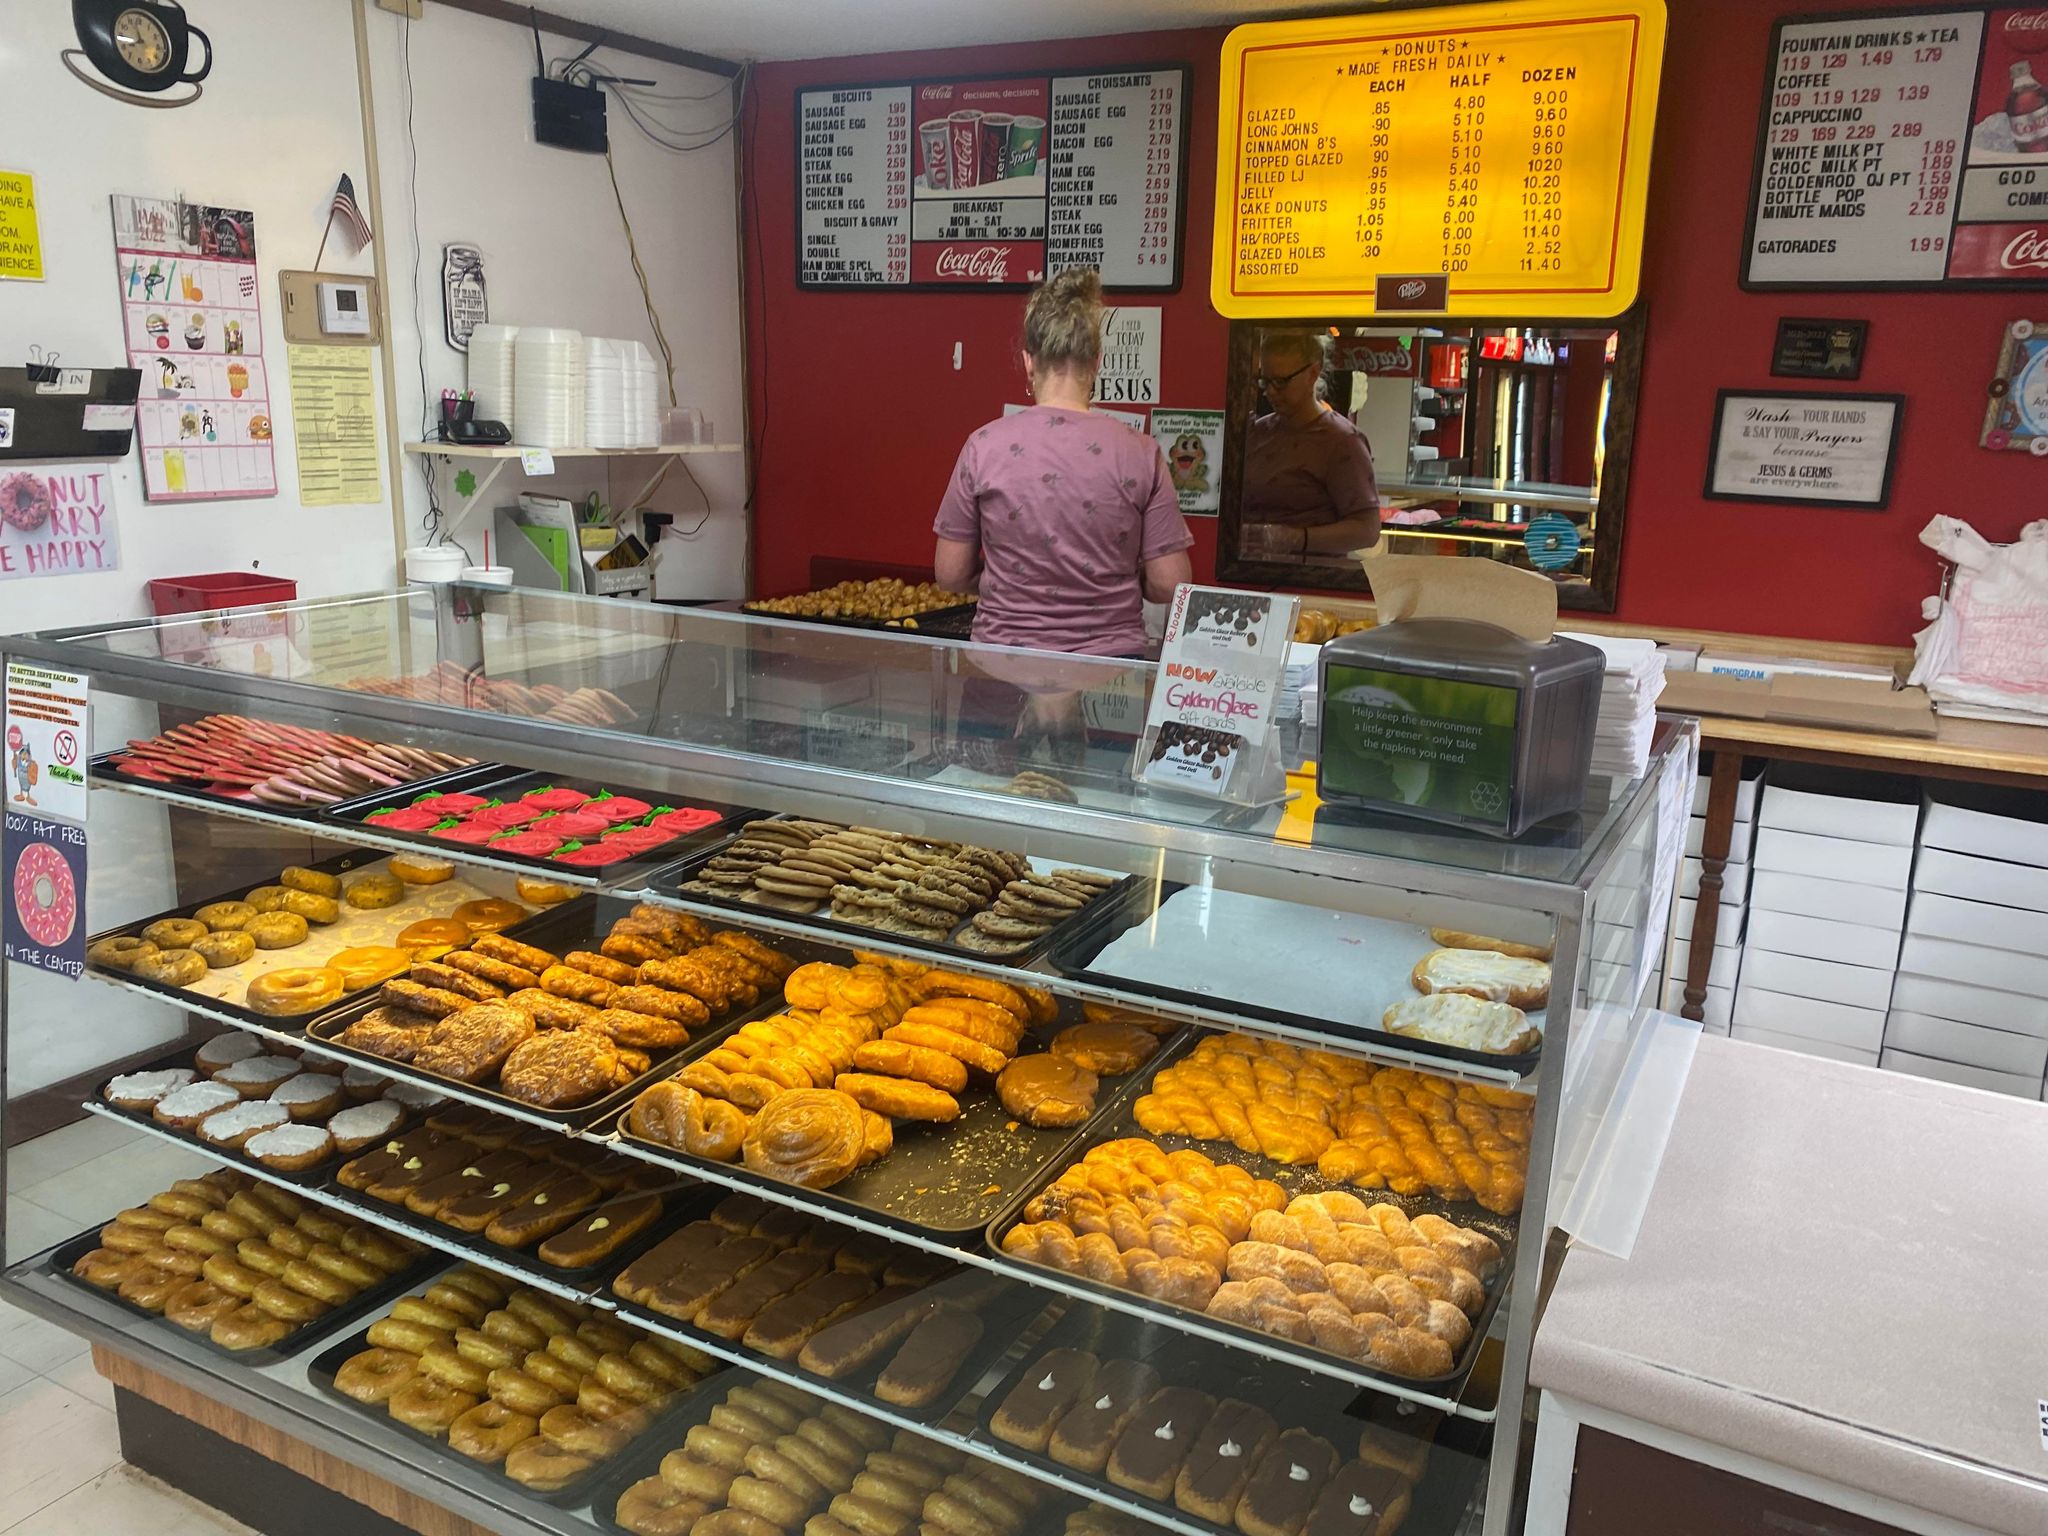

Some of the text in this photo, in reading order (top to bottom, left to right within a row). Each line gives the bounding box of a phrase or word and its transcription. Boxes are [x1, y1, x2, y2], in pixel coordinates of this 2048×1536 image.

[1782, 28, 1958, 52] FOUNTAIN DRINKS TEA
[1395, 39, 1455, 56] DONUTS
[1349, 54, 1490, 76] MADE FRESH DAILY
[1088, 75, 1151, 90] CROISSANTS
[1370, 67, 1576, 92] EACH HALF DOZEN
[1779, 73, 1830, 90] COFFEE
[833, 91, 872, 103] BISCUITS
[963, 89, 1039, 100] decisions, decisions
[1056, 93, 1101, 106] SAUSAGE
[805, 106, 845, 118] SAUSAGE
[1054, 106, 1126, 120] SAUSAGE EGG
[1248, 91, 1567, 122] GLAZED 9.00
[1772, 108, 1862, 125] CAPPUCCINO
[805, 119, 866, 131] SAUSAGE EGG
[1054, 123, 1085, 135] BACON
[1248, 122, 1318, 138] LONG JOHNS
[805, 133, 834, 144] BACON
[1054, 136, 1112, 150] BACON EGG
[804, 146, 853, 158] BACON EGG
[1246, 138, 1308, 153] CINNAMON
[1772, 143, 1884, 160] WHITE MILK PT
[1010, 147, 1037, 166] Sprite
[1053, 152, 1073, 163] HAM
[1246, 153, 1343, 168] TOPPED GLAZED
[805, 160, 831, 171] STEAK
[1052, 166, 1094, 178] HAM EGG
[1769, 159, 1882, 175] CHOC MILK PT
[806, 173, 852, 184] STEAK EGG
[1245, 170, 1304, 184] FILLED LJ
[1767, 172, 1910, 190] GOLDENROD OJ PT
[1999, 170, 2035, 185] GOD
[806, 187, 843, 197] CHICKEN
[1051, 180, 1093, 192] CHICKEN
[1241, 175, 1560, 199] JELLY 10.20
[1051, 194, 1117, 206] CHICKEN EGG
[1241, 191, 1560, 214] CAKE DONUTS 10.20
[1765, 189, 1864, 204] BOTTLE POP
[27, 200, 34, 209] A
[806, 199, 865, 210] CHICKEN EGG
[953, 202, 1003, 213] BREAKFAST
[1052, 210, 1081, 220] STEAK
[1763, 204, 1865, 219] MINUTE MAIDS
[824, 216, 898, 227] BISCUIT & GRAVY
[951, 216, 1001, 226] MON SAT
[1242, 208, 1561, 229] FRITTER 11.40
[966, 227, 1044, 237] UNTIL AM
[1051, 224, 1102, 235] STEAK EGG
[807, 235, 836, 245] SINGLE
[1049, 238, 1103, 249] HOMEFRIES
[1758, 240, 1836, 253] GATORADES
[13, 244, 33, 254] ANY
[807, 248, 839, 258] DOUBLE
[1240, 247, 1325, 260] GLAZED HOLES
[1049, 252, 1104, 263] BREAKFAST
[803, 261, 845, 270] HAM BONE
[1240, 263, 1298, 275] ASSORTED
[821, 272, 860, 281] CAMPBELL
[1117, 332, 1144, 345] TODAY
[70, 375, 83, 384] IN
[1745, 407, 1866, 424] Wash YOUR HANDS
[1743, 426, 1863, 448] & SAY YOUR Prayers
[1773, 444, 1830, 457] because
[1758, 465, 1832, 479] JESUS & GERMS
[1750, 477, 1840, 489] are everywhere
[1166, 663, 1217, 684] NOW
[1218, 692, 1258, 719] Glaze
[1179, 712, 1235, 730] gift cards
[1352, 706, 1482, 735] Help keep the environment
[1363, 723, 1383, 735] little
[1386, 729, 1423, 741] greener
[1433, 735, 1453, 748] only
[1456, 738, 1477, 750] take
[1364, 738, 1466, 764] the napkins you need.
[6, 813, 85, 845] 100% FAT FREE
[19, 948, 83, 976] THE CENTER
